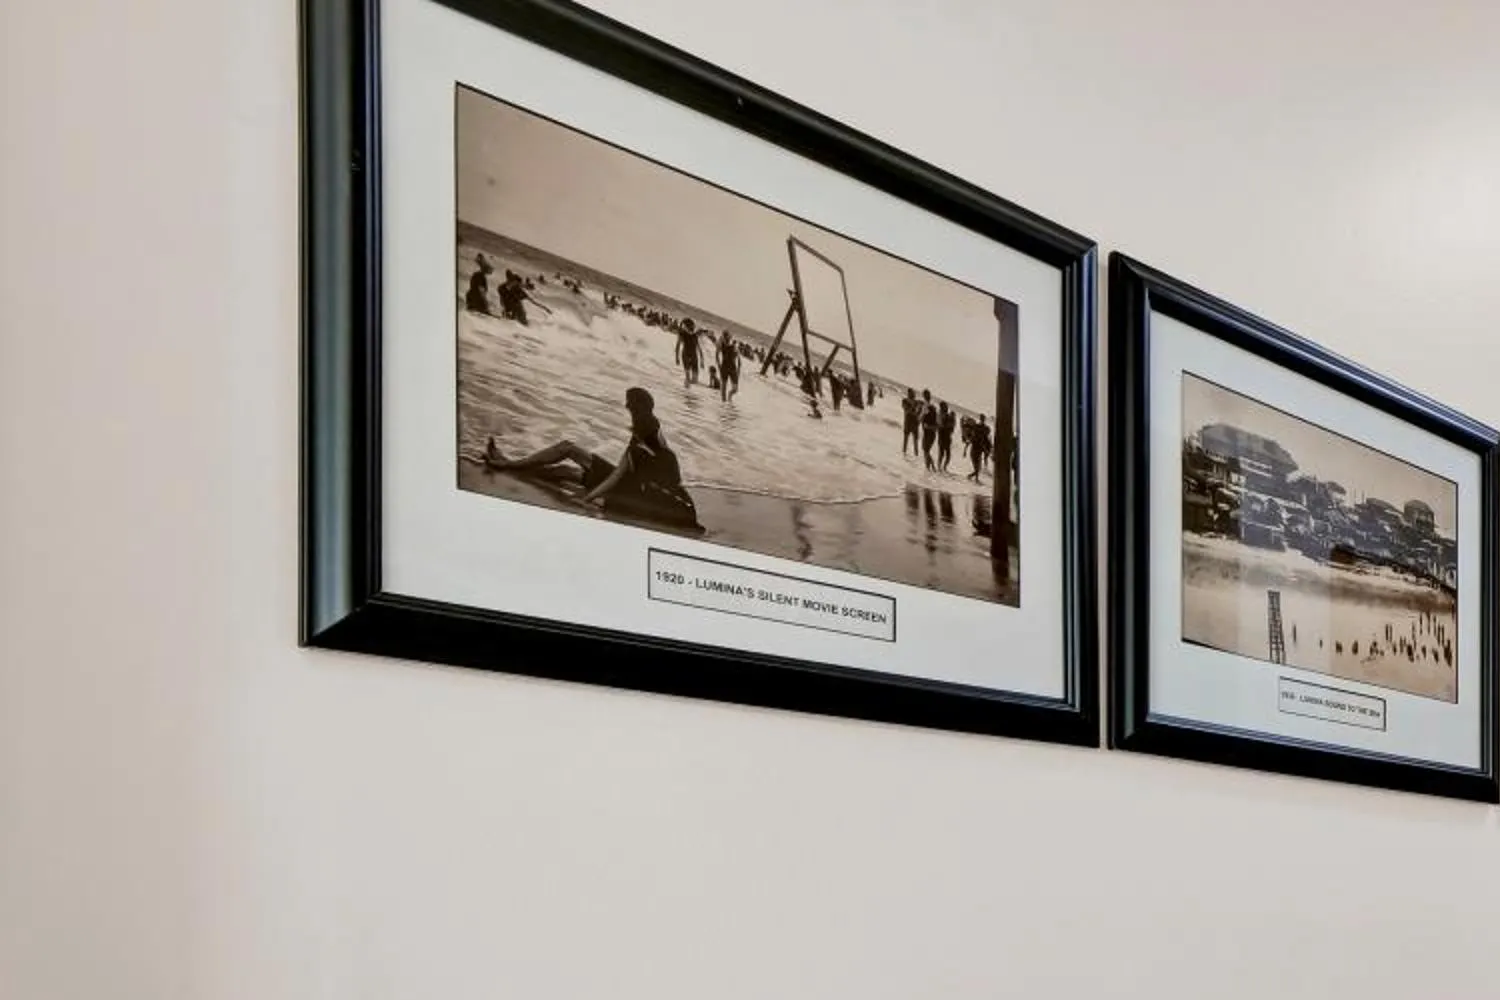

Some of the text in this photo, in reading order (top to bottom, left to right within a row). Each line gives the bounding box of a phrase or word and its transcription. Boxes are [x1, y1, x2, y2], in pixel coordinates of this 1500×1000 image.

[655, 570, 685, 585] 1920
[695, 577, 755, 599] LUMINA'S
[758, 590, 800, 607] SILENT
[802, 598, 838, 615] MOVIE
[841, 606, 887, 624] SCREEN
